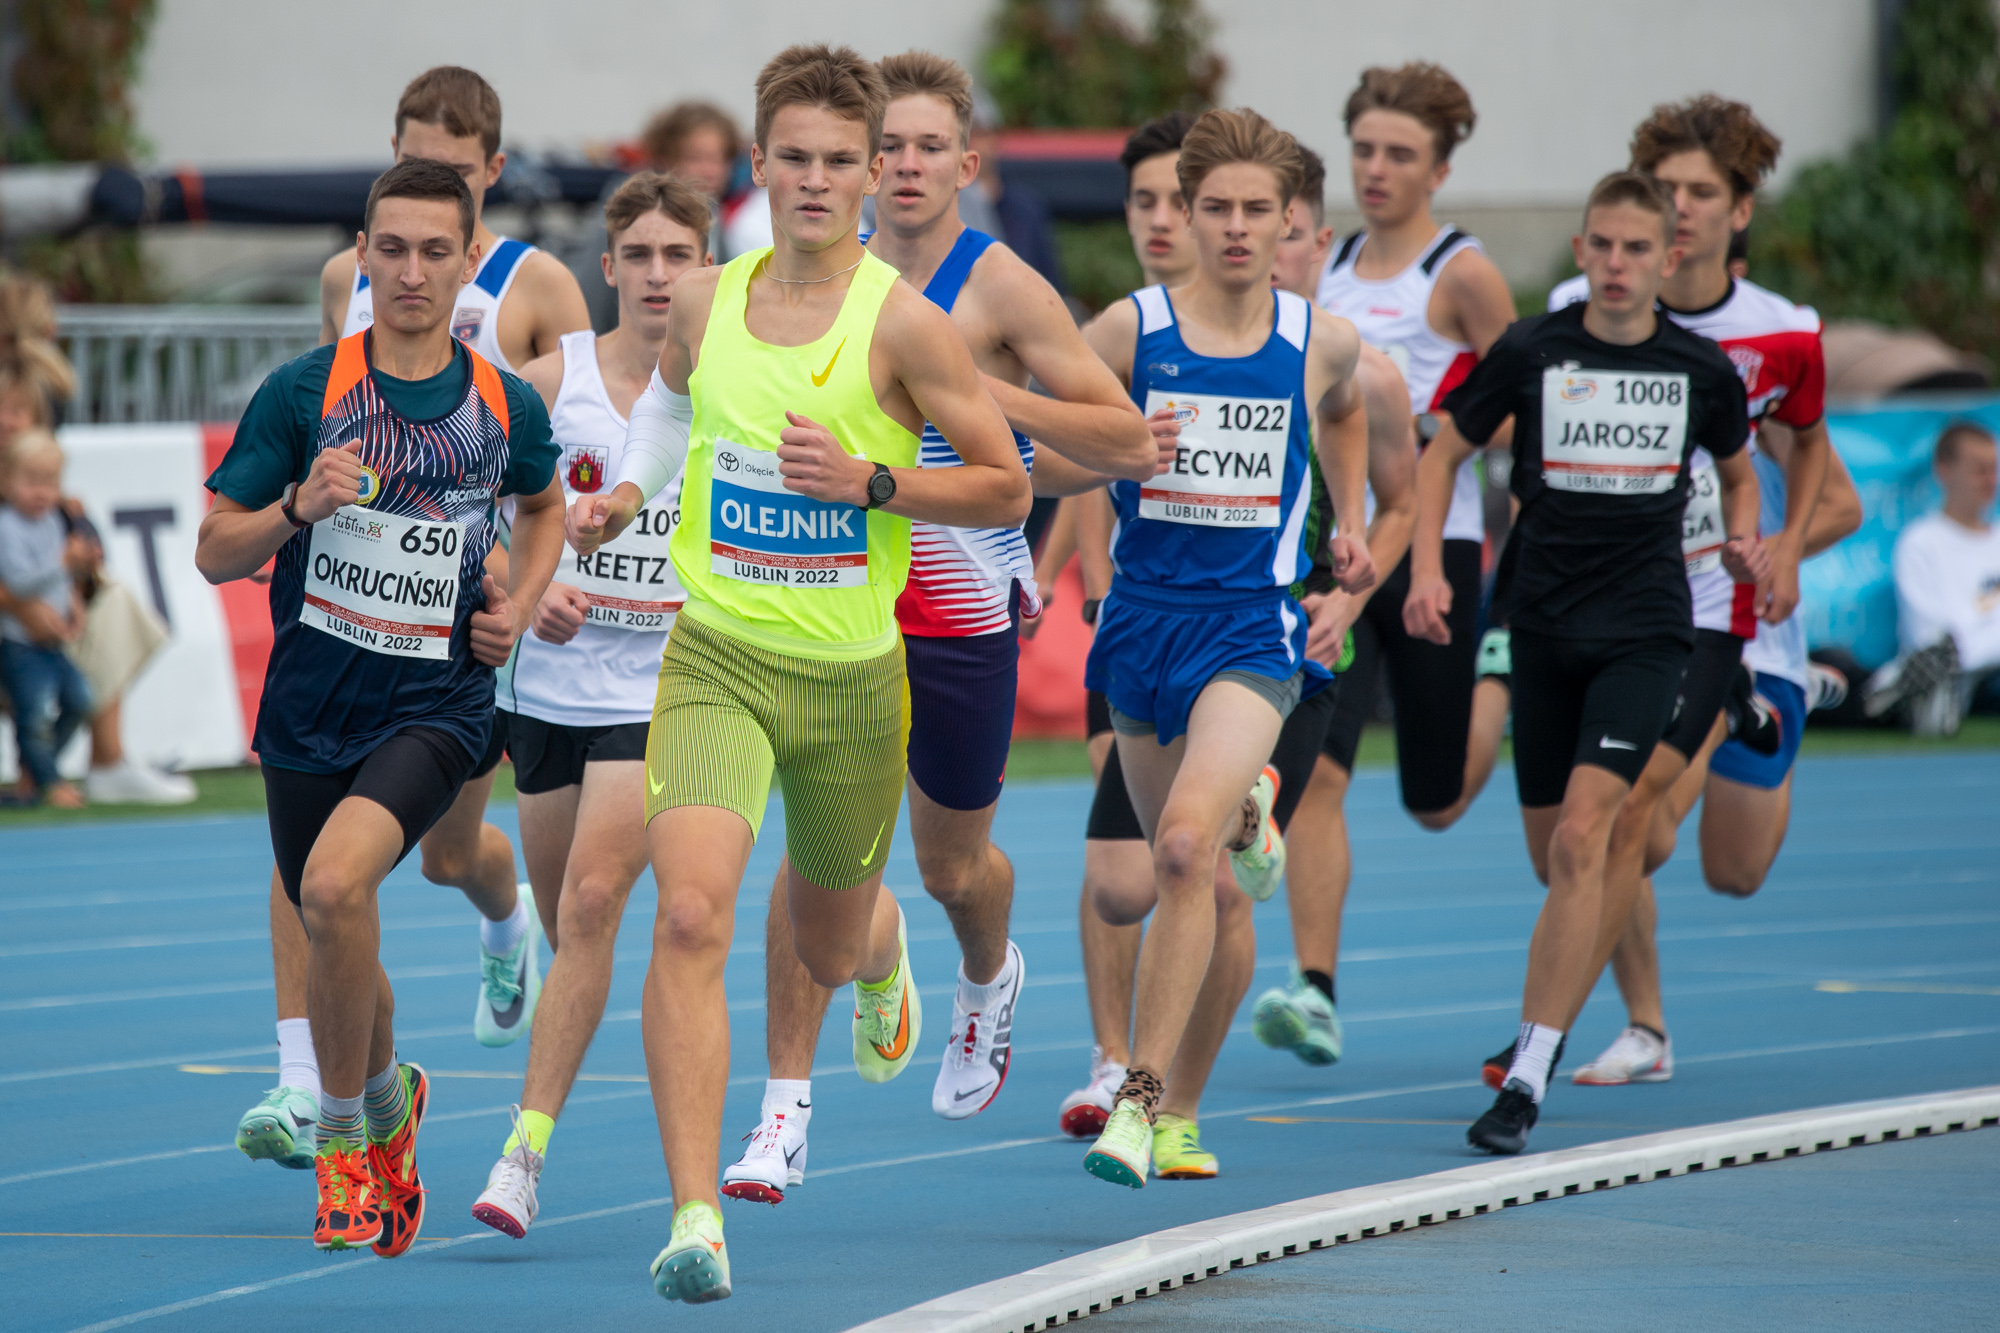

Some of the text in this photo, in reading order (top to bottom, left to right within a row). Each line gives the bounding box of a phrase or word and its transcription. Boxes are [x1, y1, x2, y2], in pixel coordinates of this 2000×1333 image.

[1615, 379, 1682, 406] 1008
[1173, 410, 1192, 420] OTTO
[1218, 403, 1285, 432] 1022
[1559, 422, 1670, 450] JAROSZ
[744, 463, 775, 478] Okęcie
[1174, 448, 1272, 479] ECYNA
[444, 487, 493, 503] DECATHLON
[1566, 475, 1656, 490] LUBLIN 2022
[636, 508, 682, 537] 10
[720, 498, 855, 540] OLEJNIK
[1165, 503, 1259, 522] LUBLIN 2022
[331, 527, 382, 544] MIASTO INSPIRACJI
[1682, 514, 1714, 539] GA
[400, 525, 458, 557] 650
[314, 552, 455, 608] OKRUCIŃSKI
[577, 551, 668, 585] REETZ
[734, 561, 839, 584] LUBLIN 2022
[586, 607, 664, 627] BLIN 2022
[326, 615, 423, 651] LUBLIN 2022
